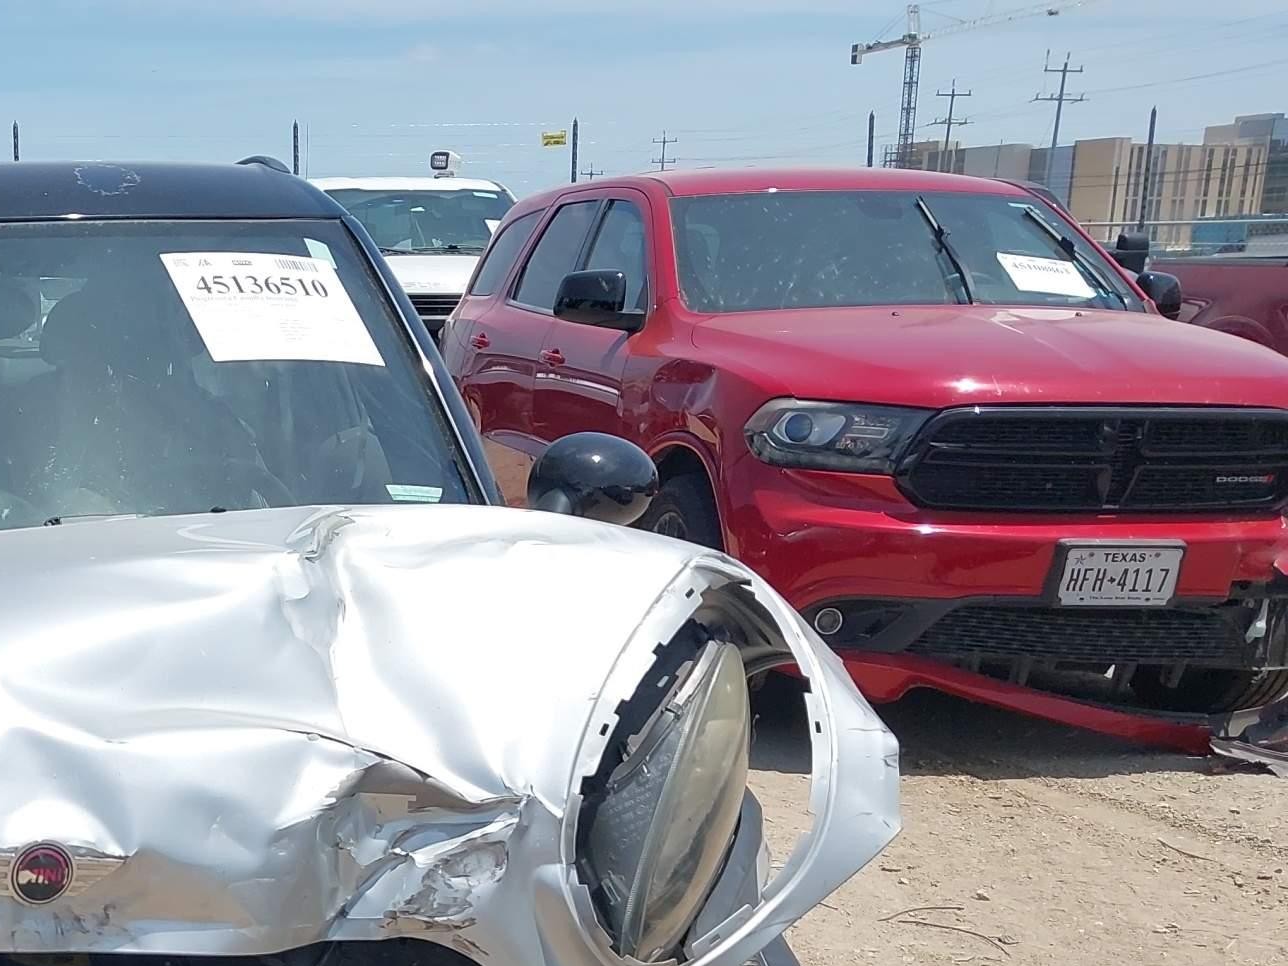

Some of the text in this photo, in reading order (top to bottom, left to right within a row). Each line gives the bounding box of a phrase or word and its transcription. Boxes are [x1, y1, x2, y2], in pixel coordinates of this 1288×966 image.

[196, 275, 329, 298] 45136510
[1104, 552, 1146, 563] TEXAS
[1116, 567, 1170, 593] 4117
